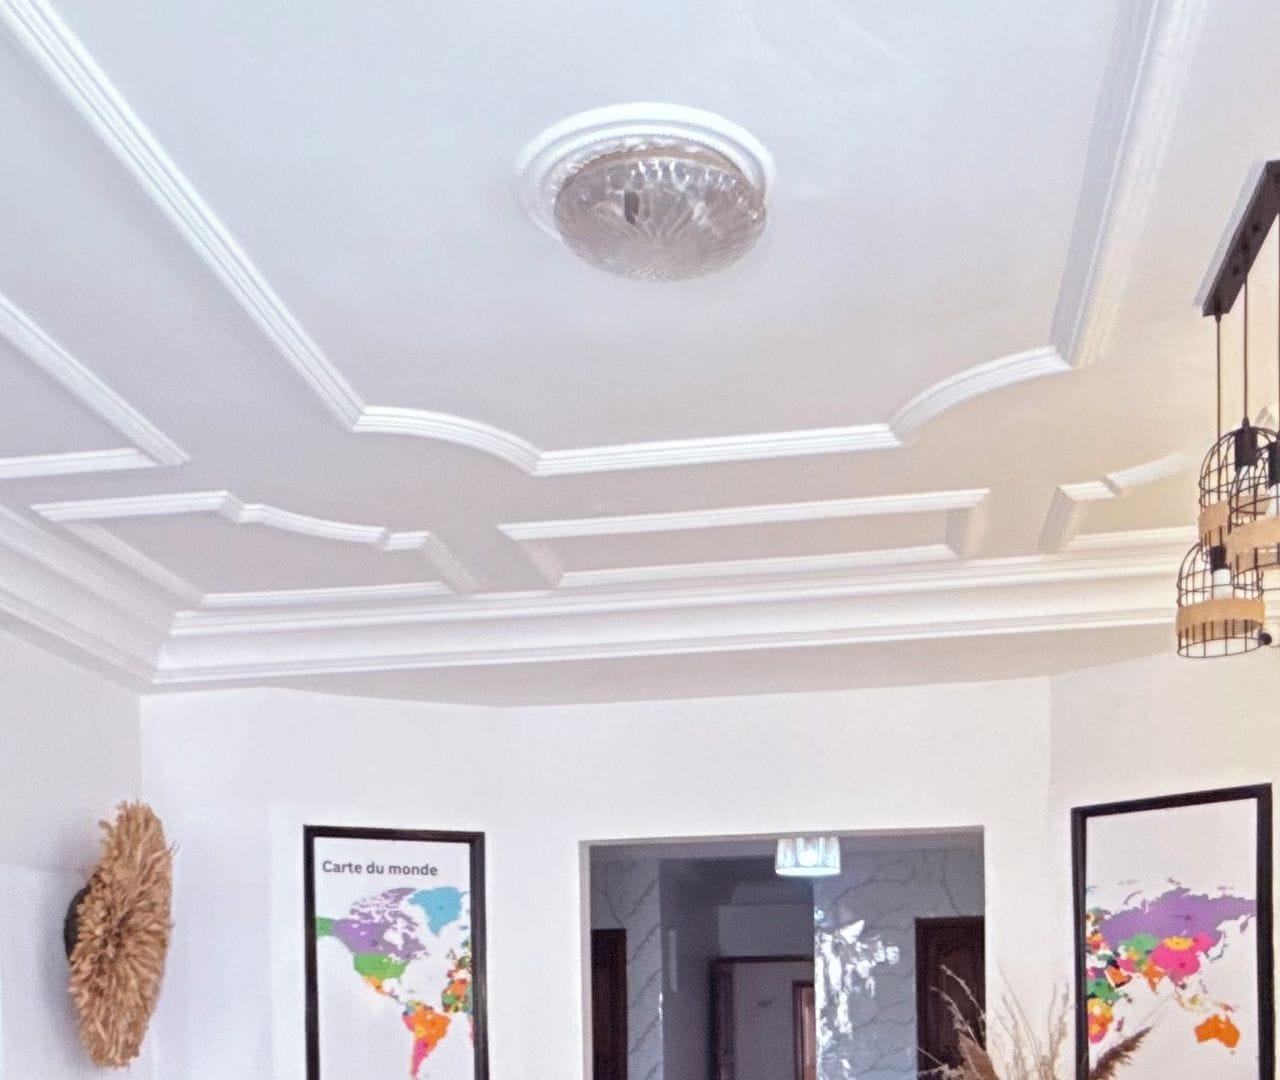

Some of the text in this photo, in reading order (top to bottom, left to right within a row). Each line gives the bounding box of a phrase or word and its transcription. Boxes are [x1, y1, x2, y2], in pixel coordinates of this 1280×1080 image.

[322, 860, 438, 876] Carte du monde
